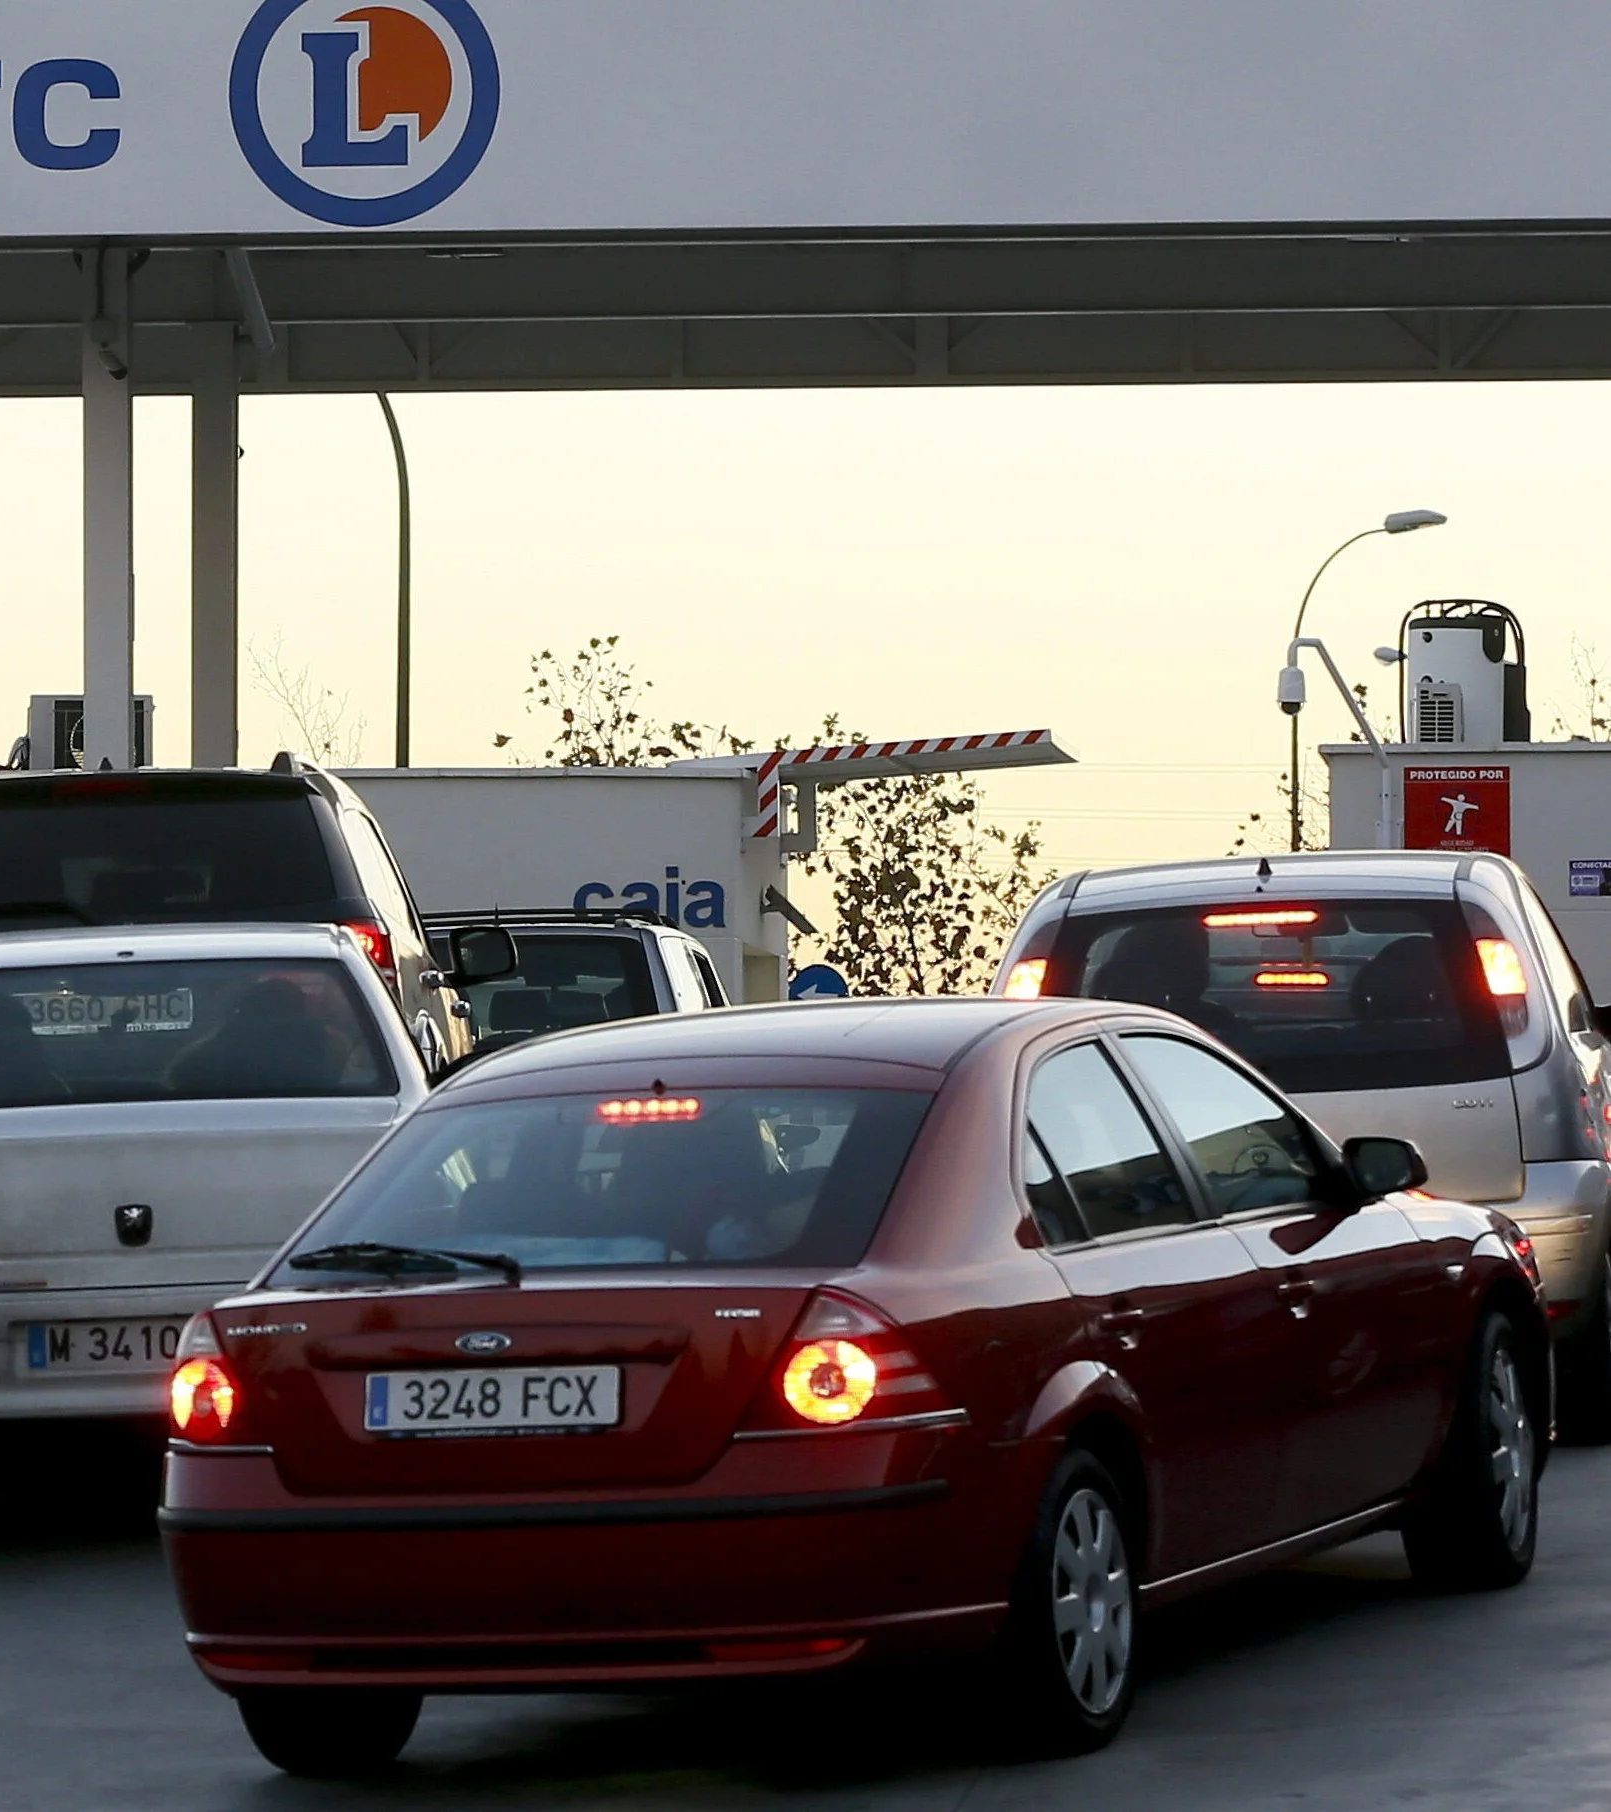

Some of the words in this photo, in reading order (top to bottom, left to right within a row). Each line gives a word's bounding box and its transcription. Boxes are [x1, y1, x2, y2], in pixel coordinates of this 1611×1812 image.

[1410, 771, 1476, 780] PROTEGIDO
[1479, 770, 1504, 780] POR
[29, 997, 104, 1023] 3660
[49, 1328, 71, 1362] M
[88, 1325, 180, 1361] 3410
[403, 1378, 501, 1421] 3248
[521, 1375, 598, 1418] FCX
